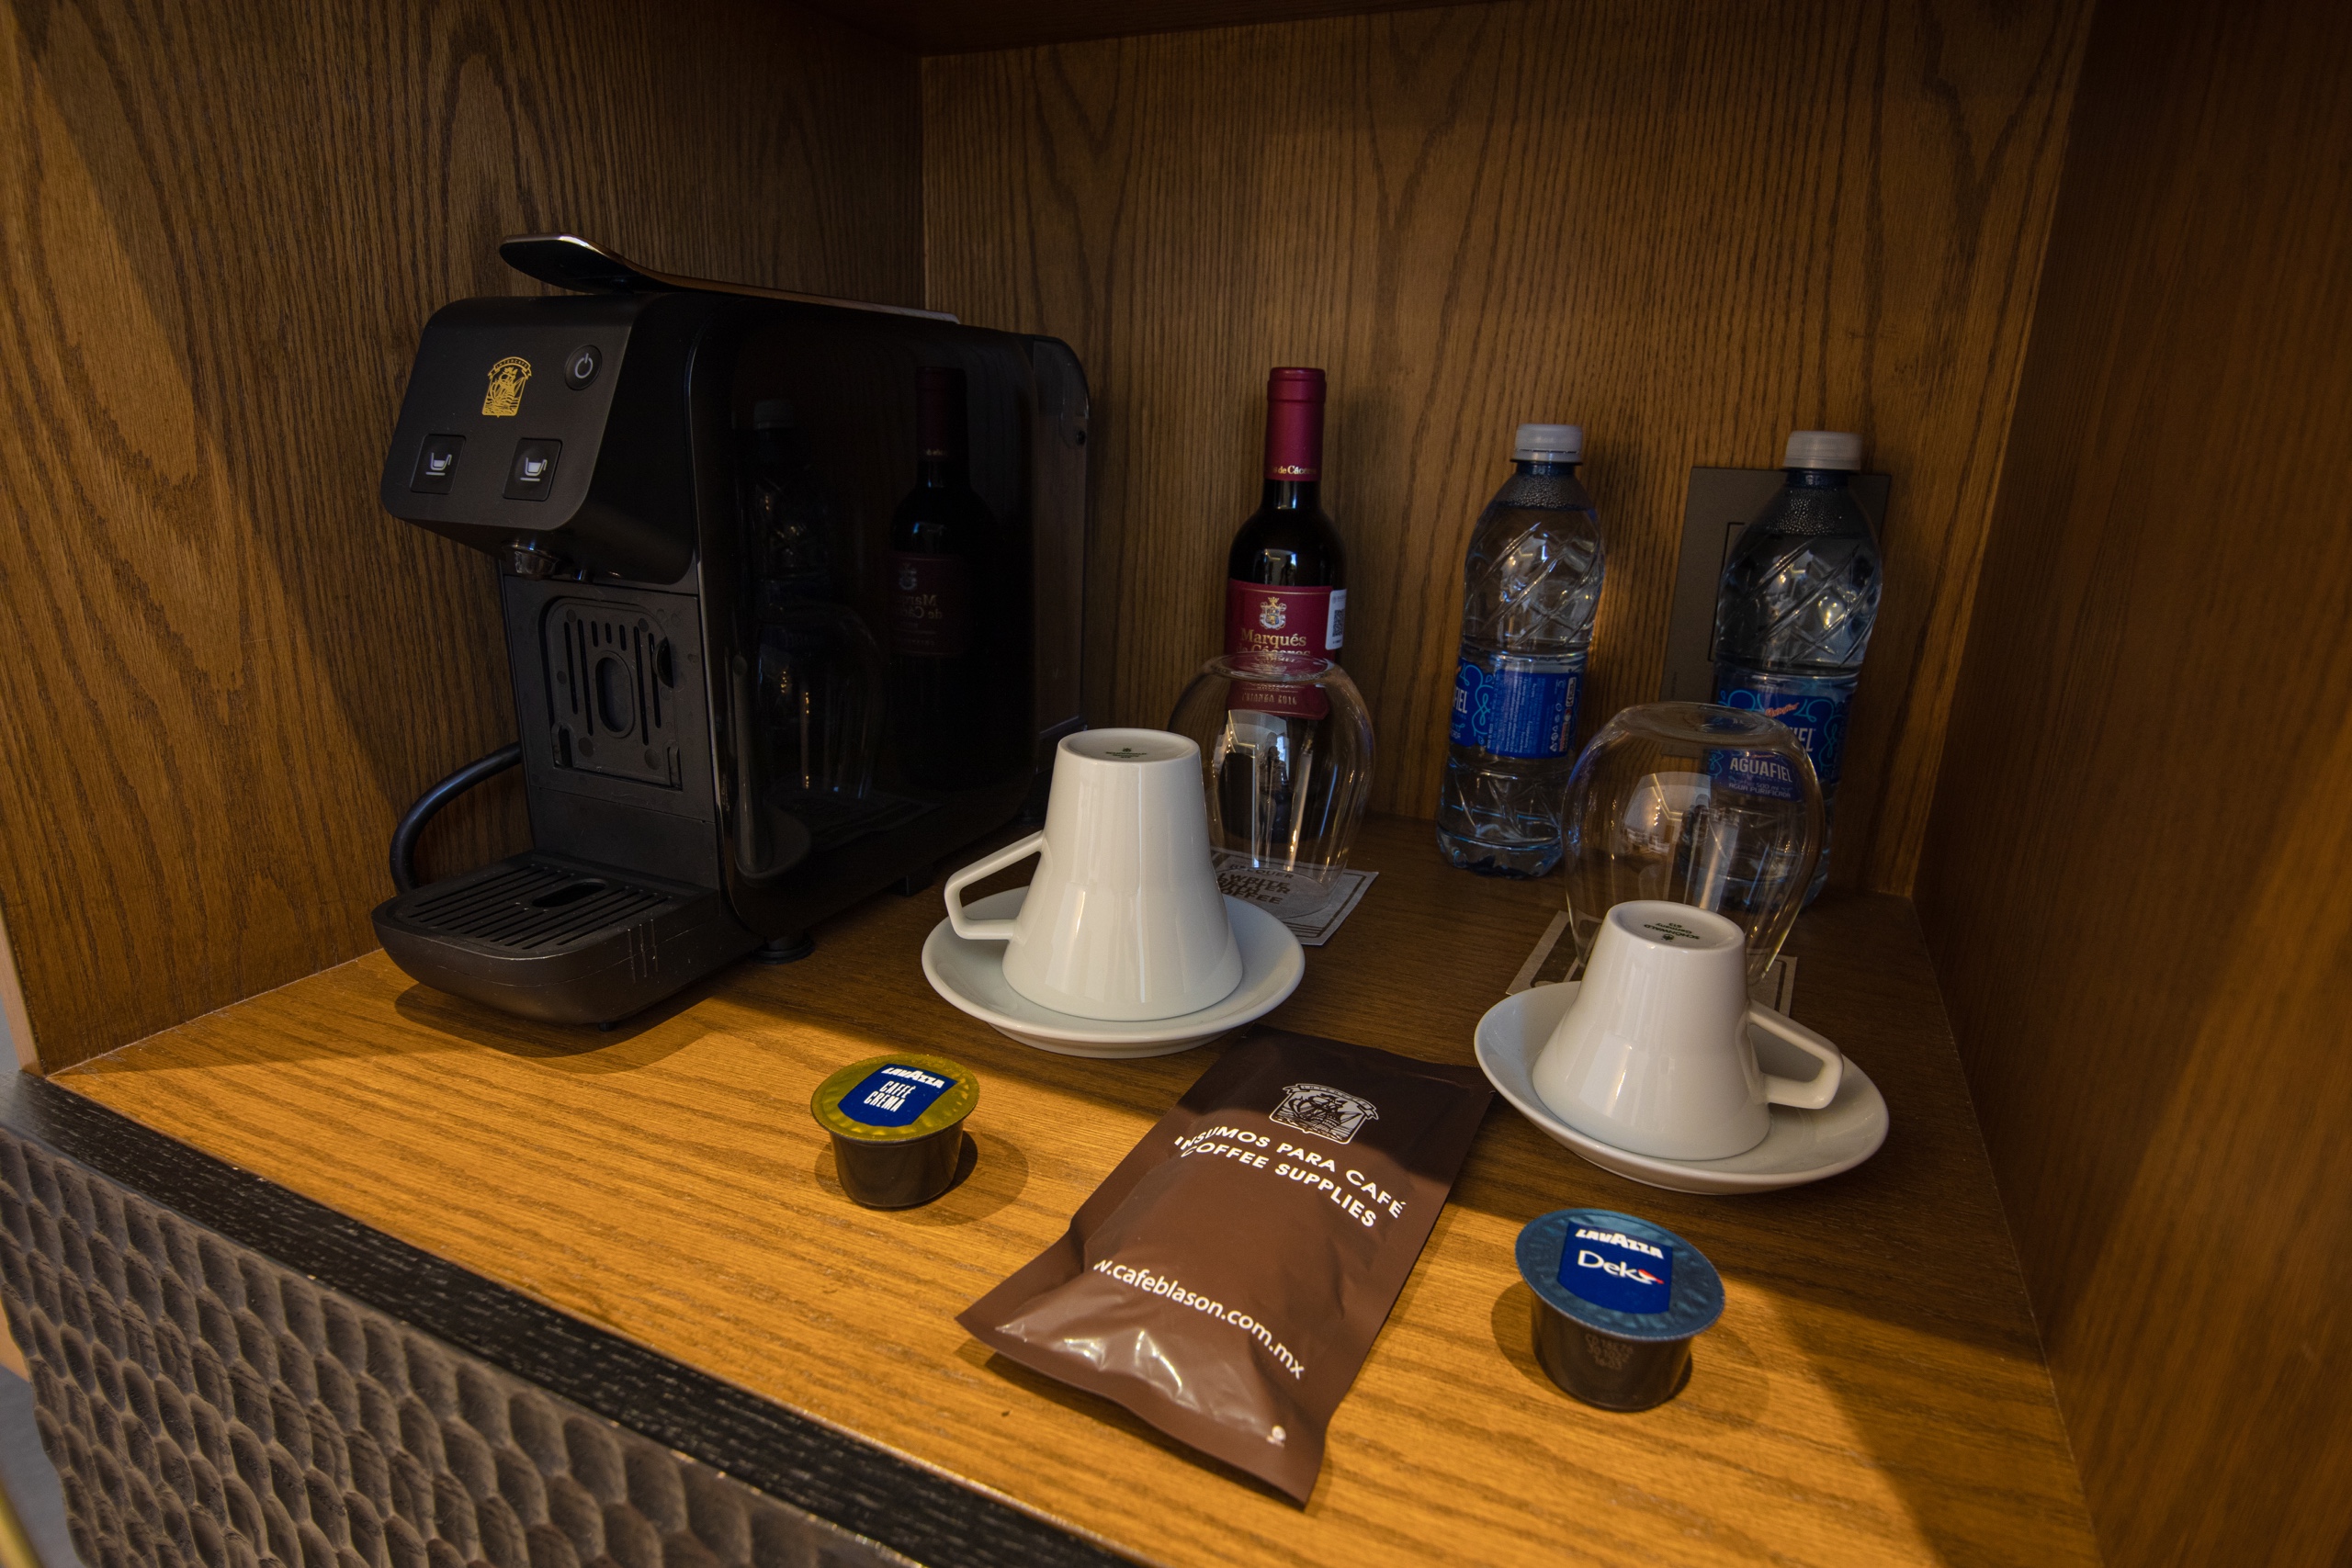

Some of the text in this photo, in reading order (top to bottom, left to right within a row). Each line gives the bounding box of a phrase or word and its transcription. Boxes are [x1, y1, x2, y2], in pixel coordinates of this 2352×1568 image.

[1240, 627, 1306, 649] Marqués
[1729, 757, 1793, 783] AGUAFIEL
[1749, 787, 1791, 798] PURIFICADA
[1220, 888, 1283, 905] OFFEE
[880, 1066, 945, 1089] LAVAZZA
[863, 1090, 906, 1112] CREMA
[1174, 1126, 1407, 1218] INSUMOS PARA CAFÉ
[1181, 1143, 1377, 1227] COFFEE SUPPLIES
[1575, 1228, 1665, 1259] LAVAZZA
